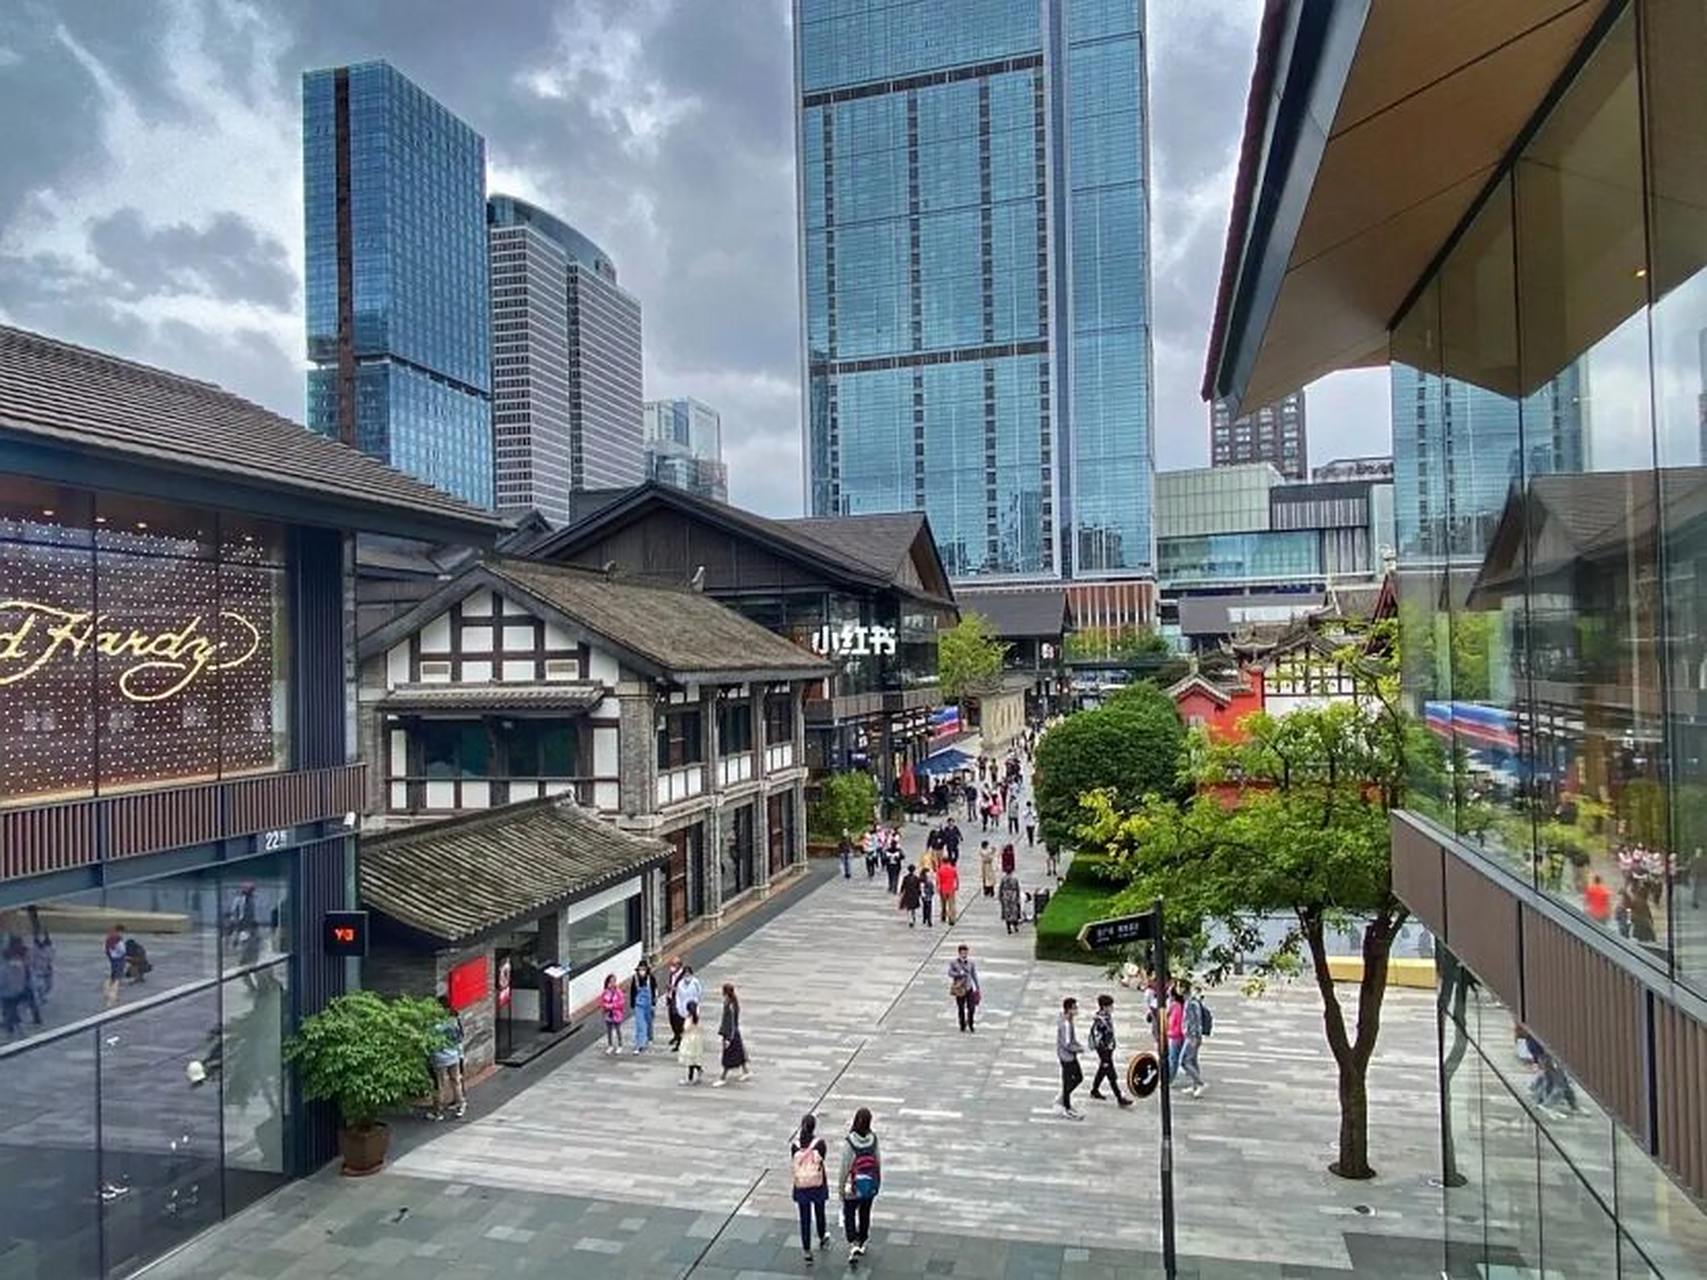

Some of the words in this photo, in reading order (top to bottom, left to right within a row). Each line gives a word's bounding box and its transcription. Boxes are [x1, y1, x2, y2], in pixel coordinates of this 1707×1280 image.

[20, 599, 259, 701] Hardy
[811, 625, 896, 655] 小红书
